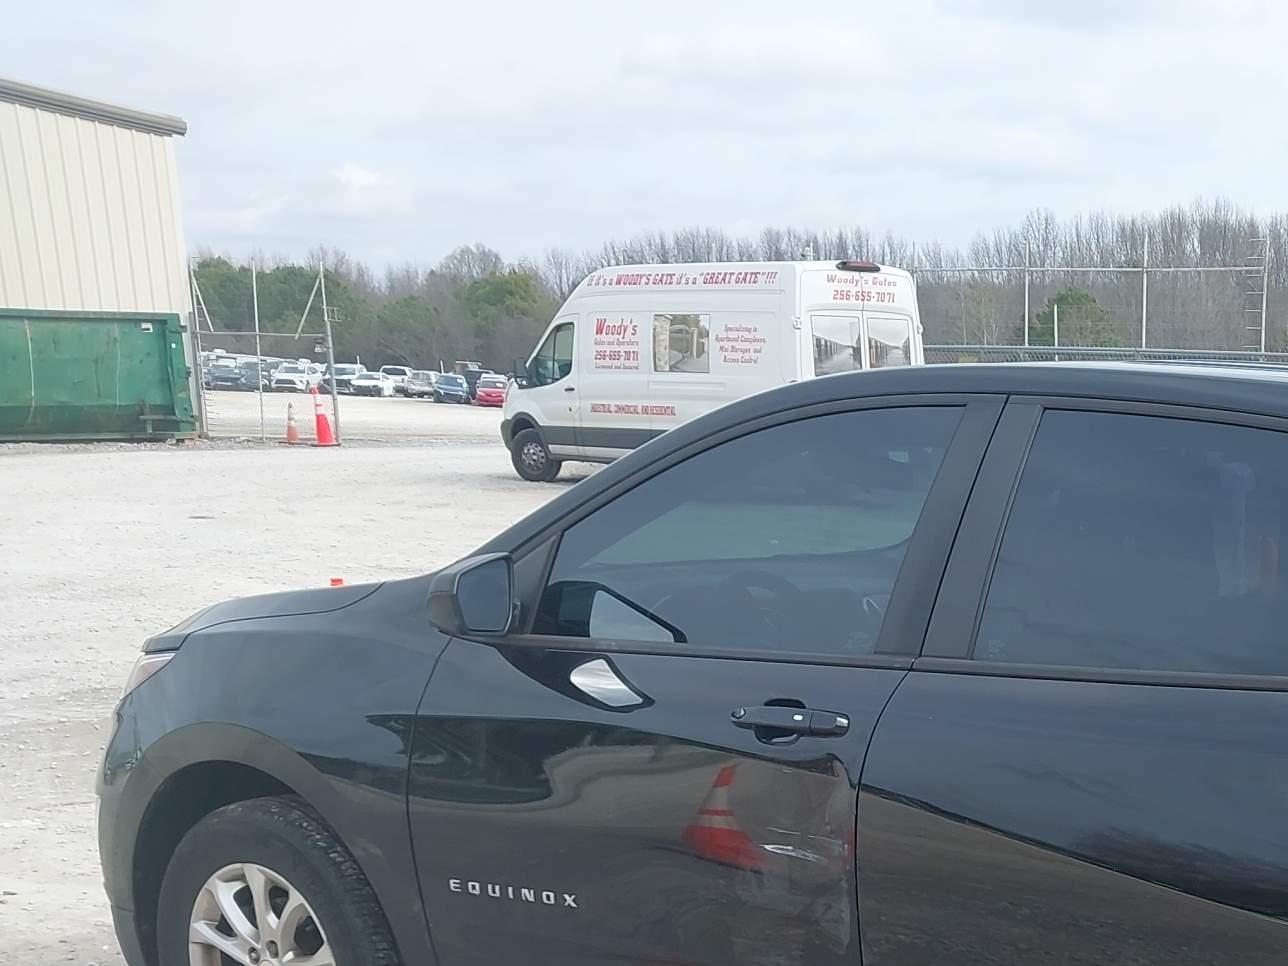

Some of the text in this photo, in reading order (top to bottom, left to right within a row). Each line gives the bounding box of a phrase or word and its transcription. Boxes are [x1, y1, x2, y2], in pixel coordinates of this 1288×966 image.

[608, 278, 614, 286] a
[615, 273, 652, 286] WOODY'S
[652, 273, 676, 285] GATE
[676, 272, 690, 285] it's
[692, 277, 697, 285] a
[826, 274, 897, 287] Woody's Gates
[832, 289, 896, 303] 256-655-7071
[595, 317, 638, 339] Woody's
[594, 350, 639, 361] 256-655-7071
[449, 878, 578, 908] EQUINOX
